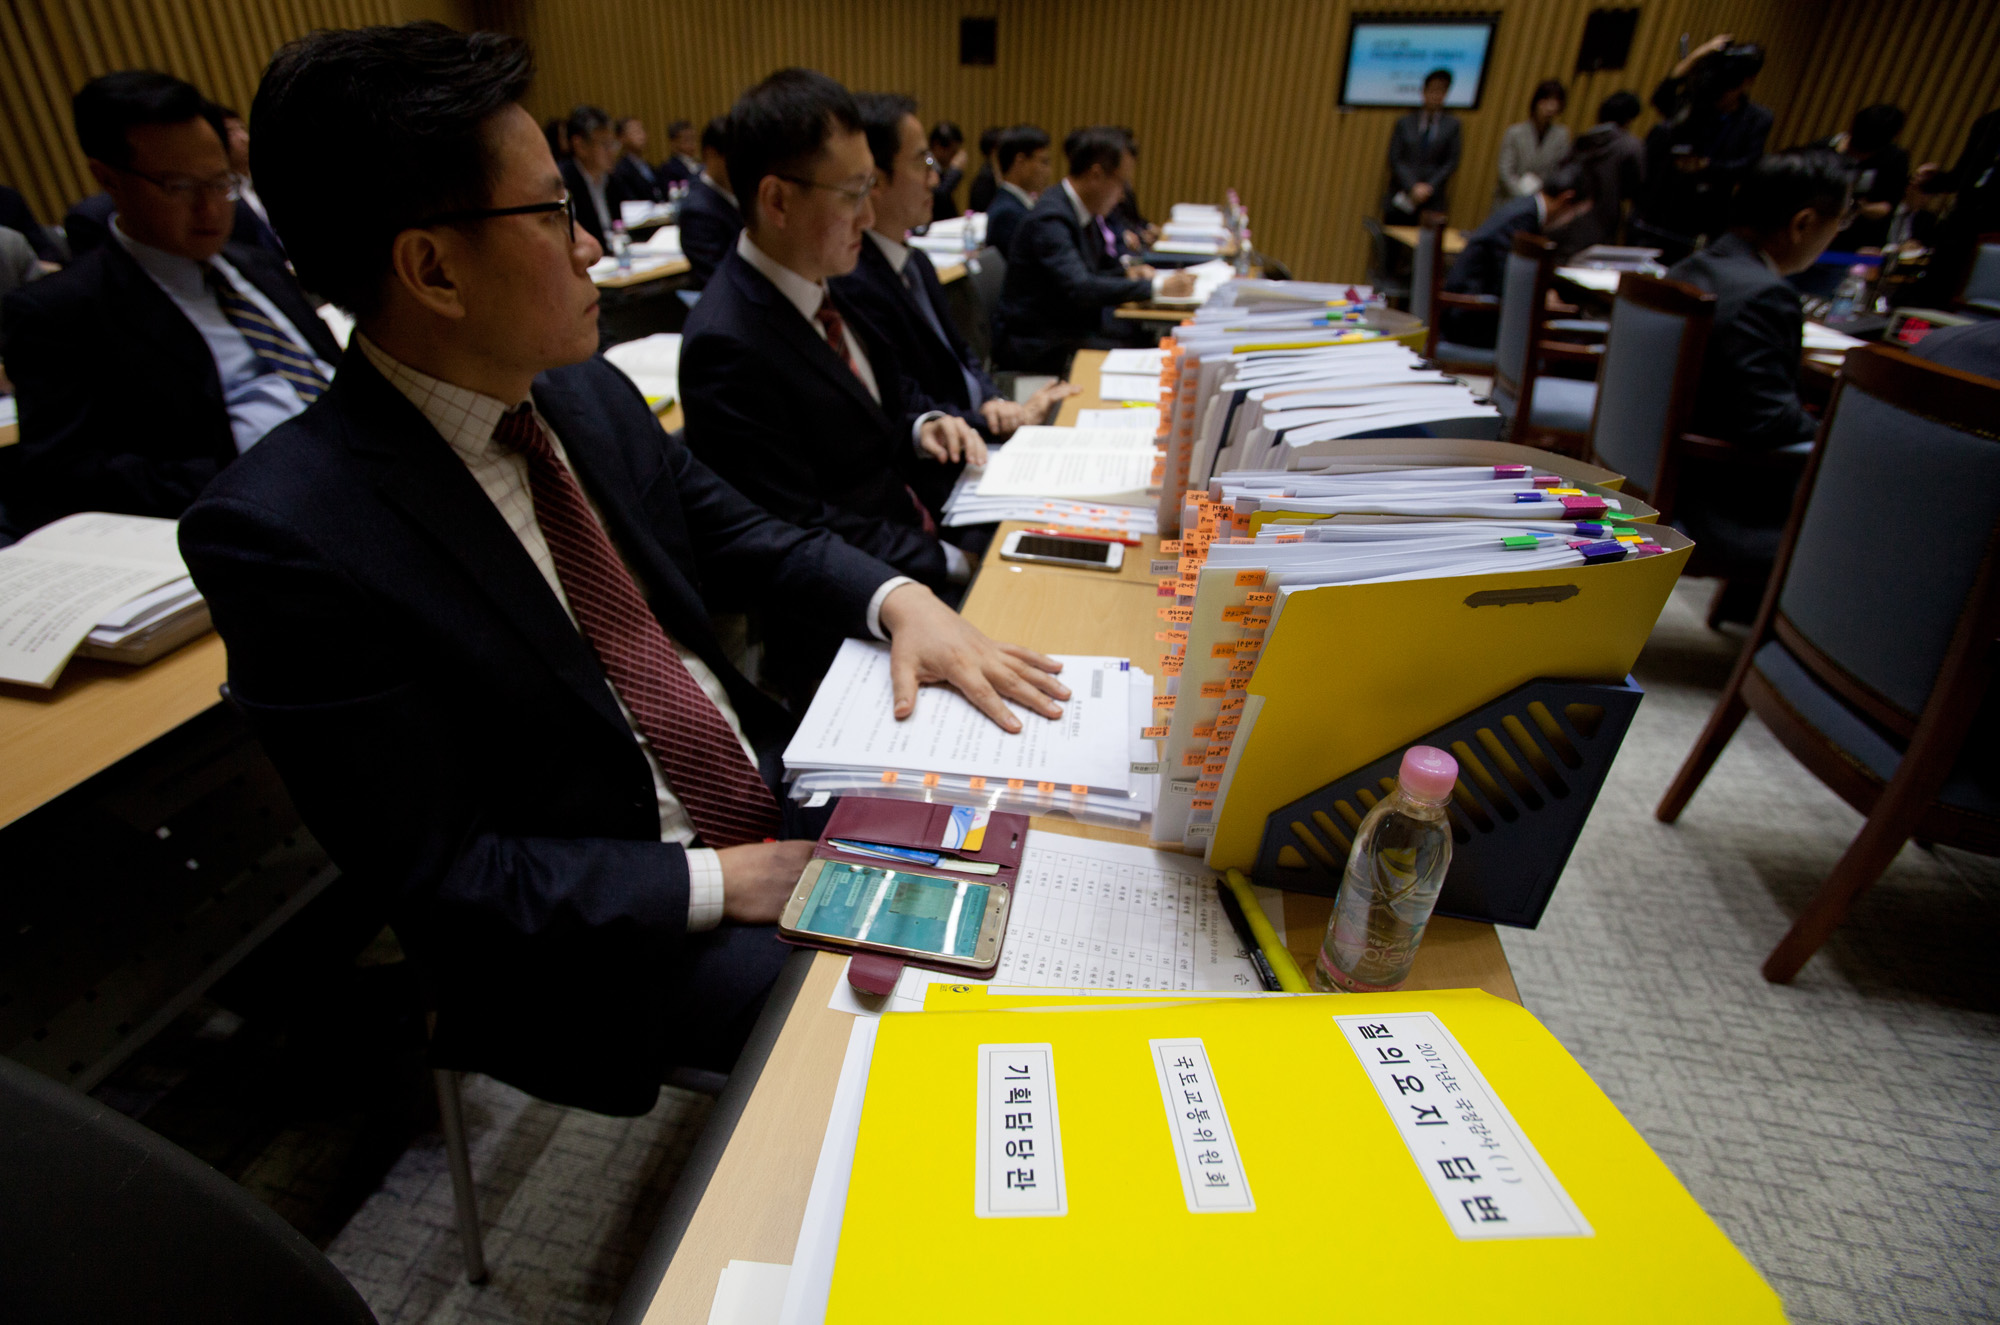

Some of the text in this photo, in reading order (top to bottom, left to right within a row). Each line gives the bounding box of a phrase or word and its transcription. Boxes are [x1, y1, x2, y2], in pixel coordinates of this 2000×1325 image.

[1004, 1065, 1037, 1190] 기획담당관
[1174, 1056, 1229, 1188] 국토교통위원회
[1415, 1043, 1461, 1093] 2017년도
[1455, 1098, 1500, 1150] 국정감사
